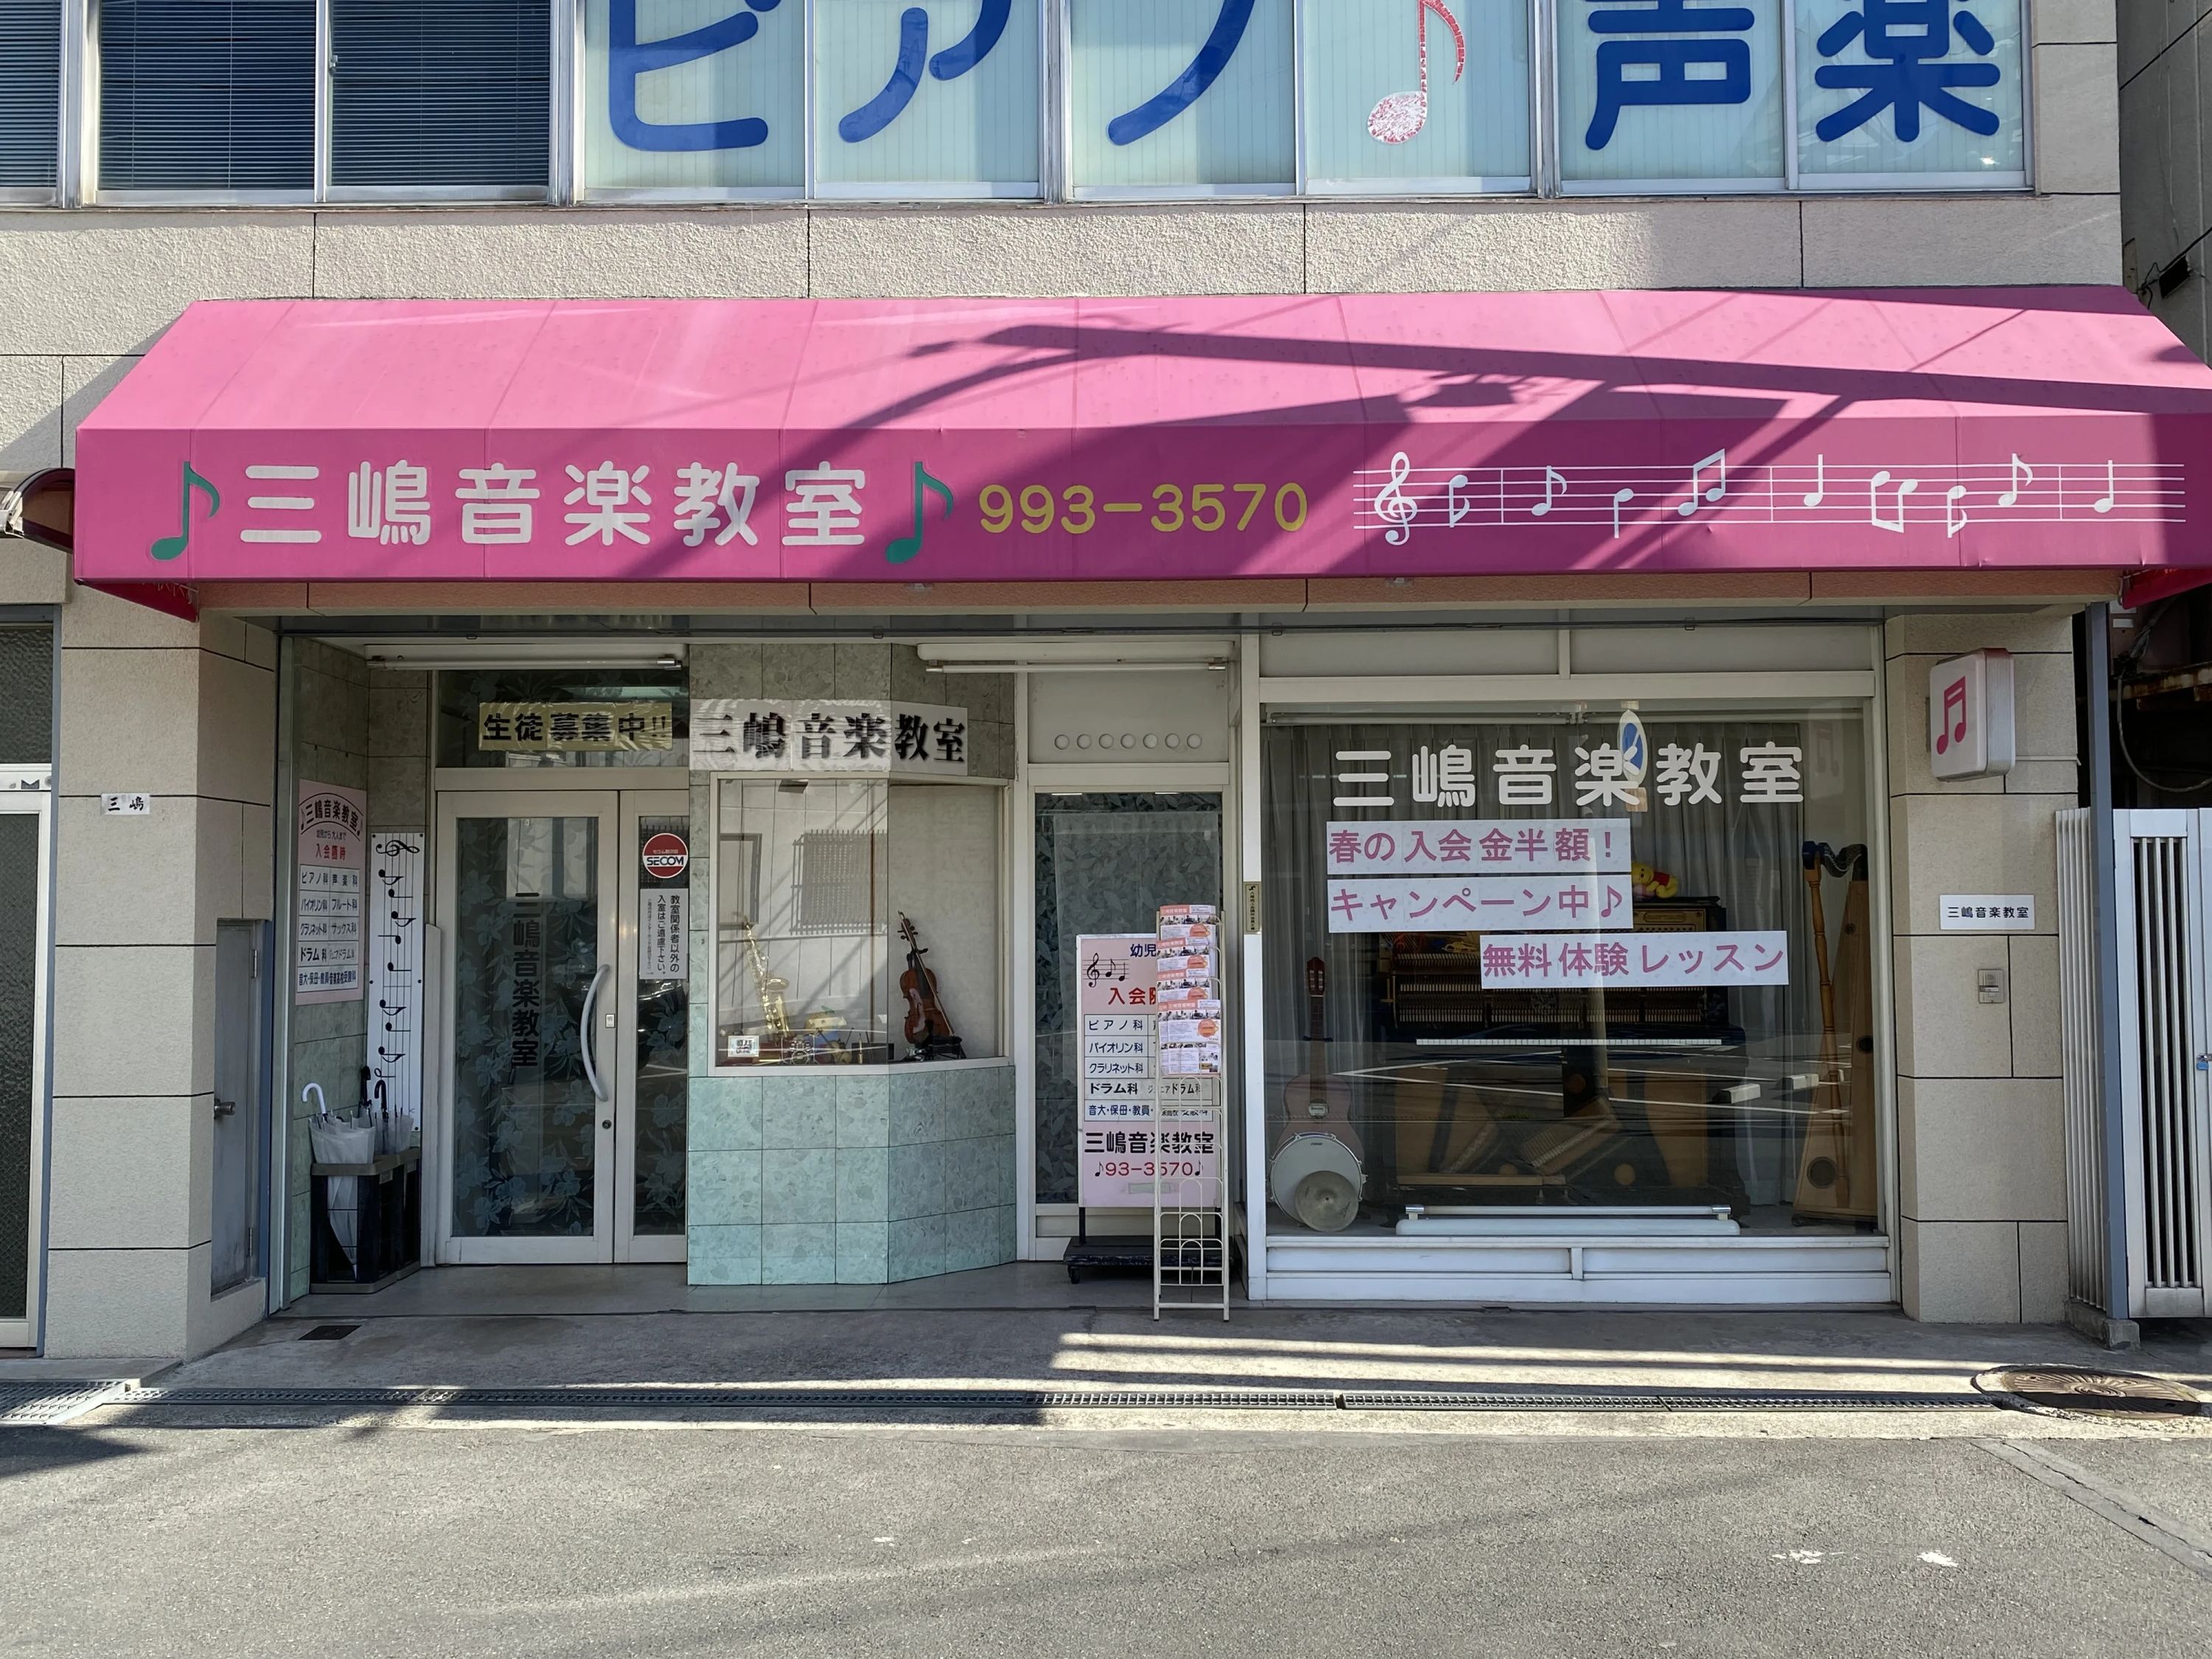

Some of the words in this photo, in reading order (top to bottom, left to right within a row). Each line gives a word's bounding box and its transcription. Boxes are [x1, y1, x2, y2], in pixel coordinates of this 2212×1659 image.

[239, 460, 866, 547] 三嶋音楽教室
[692, 712, 965, 763] 三嶋音楽教室
[1333, 741, 1804, 807] 三嶋音楽教室
[305, 799, 359, 832] 三嶋音楽教室
[647, 856, 684, 866] SECOM
[1947, 905, 2030, 919] 三嶋音楽教室
[670, 895, 680, 973] 教室関係者以外の
[1482, 942, 1784, 978] 無料体験レッスン
[511, 892, 540, 1068] 三嶋音楽教室
[1088, 1020, 1143, 1031] ピアノ科
[1089, 1043, 1143, 1054] バイオリン科
[1089, 1062, 1143, 1074] クラリネット科
[1090, 1082, 1138, 1094] ドラム科
[1147, 1084, 1202, 1094] ジニアドラム科
